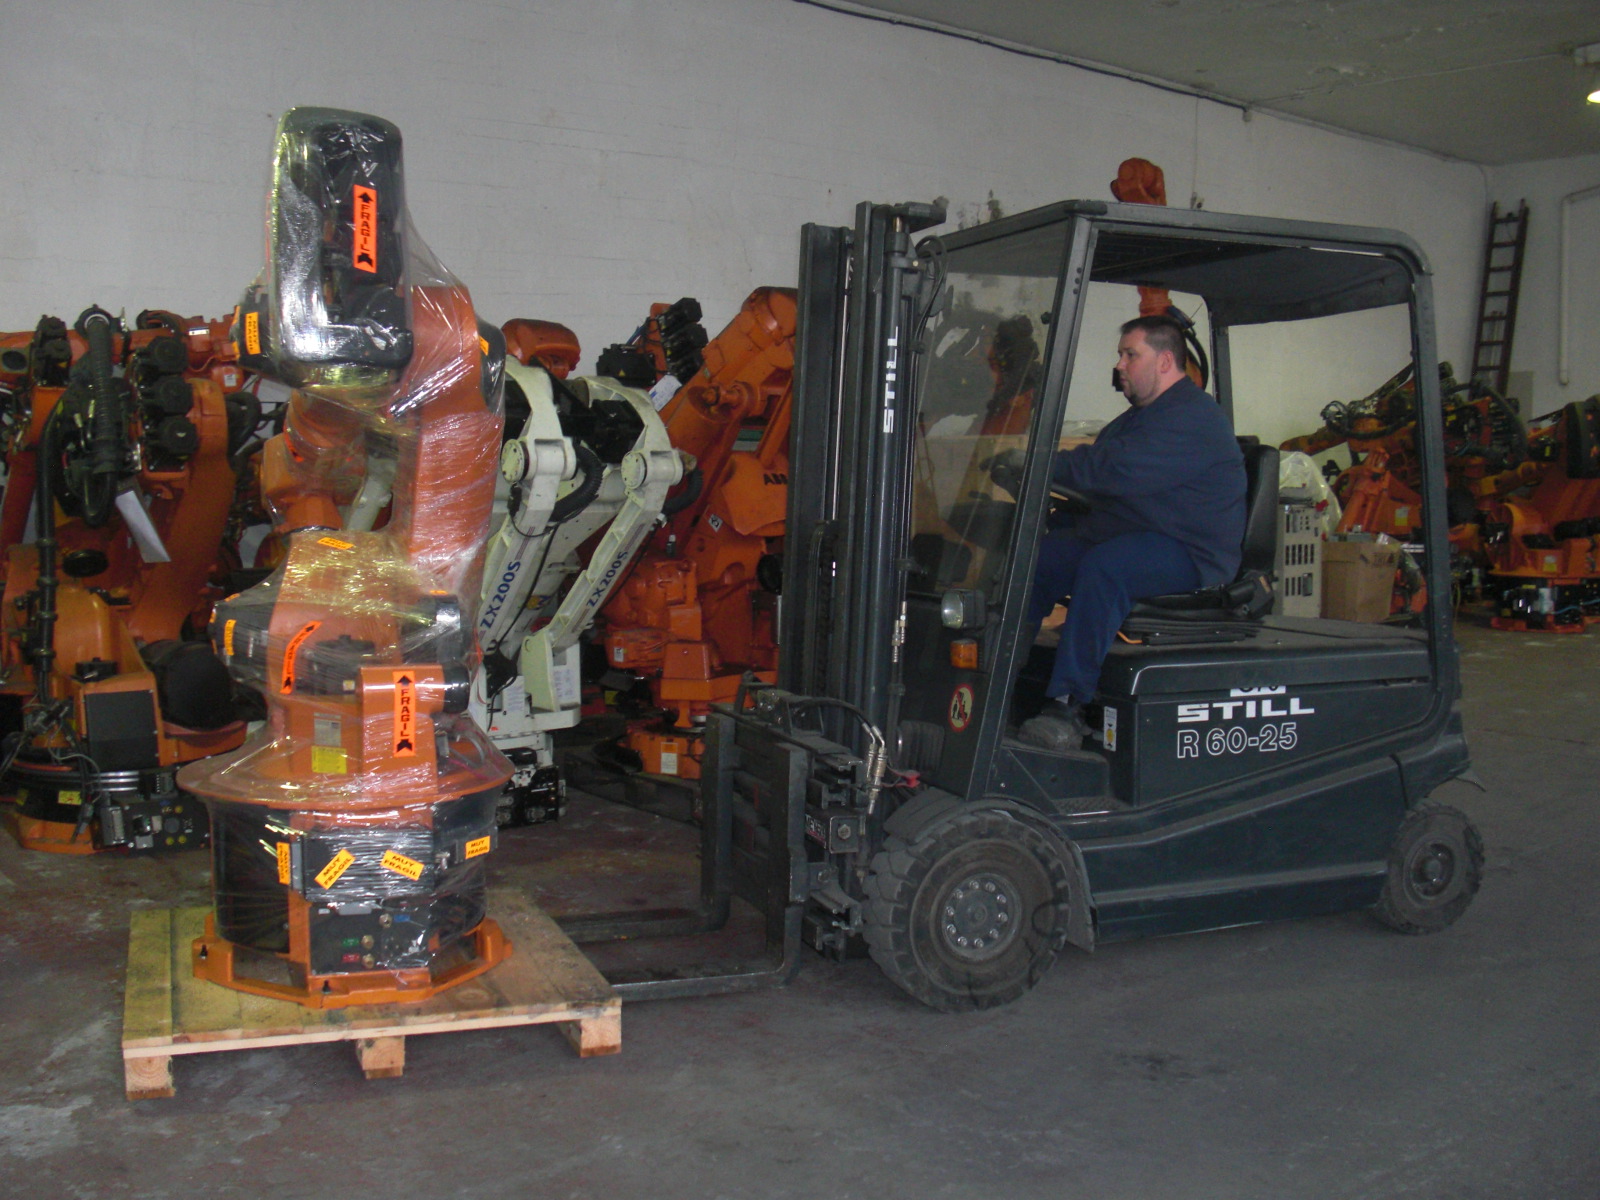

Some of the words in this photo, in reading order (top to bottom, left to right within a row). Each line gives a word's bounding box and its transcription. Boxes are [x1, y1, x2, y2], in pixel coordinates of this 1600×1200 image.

[360, 204, 371, 252] FRAGIL
[883, 325, 899, 434] STILL
[586, 551, 628, 607] ZX200S
[480, 560, 521, 629] ZX200S
[400, 688, 411, 737] FRAGIL
[1177, 697, 1315, 723] STILL
[1177, 729, 1200, 759] R
[1205, 721, 1298, 756] 60-25
[467, 845, 488, 856] FRAGIL
[470, 839, 486, 848] MUY
[323, 857, 341, 876] MUY
[324, 858, 352, 886] FRAGIL
[384, 859, 418, 877] FRAGIL
[392, 855, 414, 867] MUY
